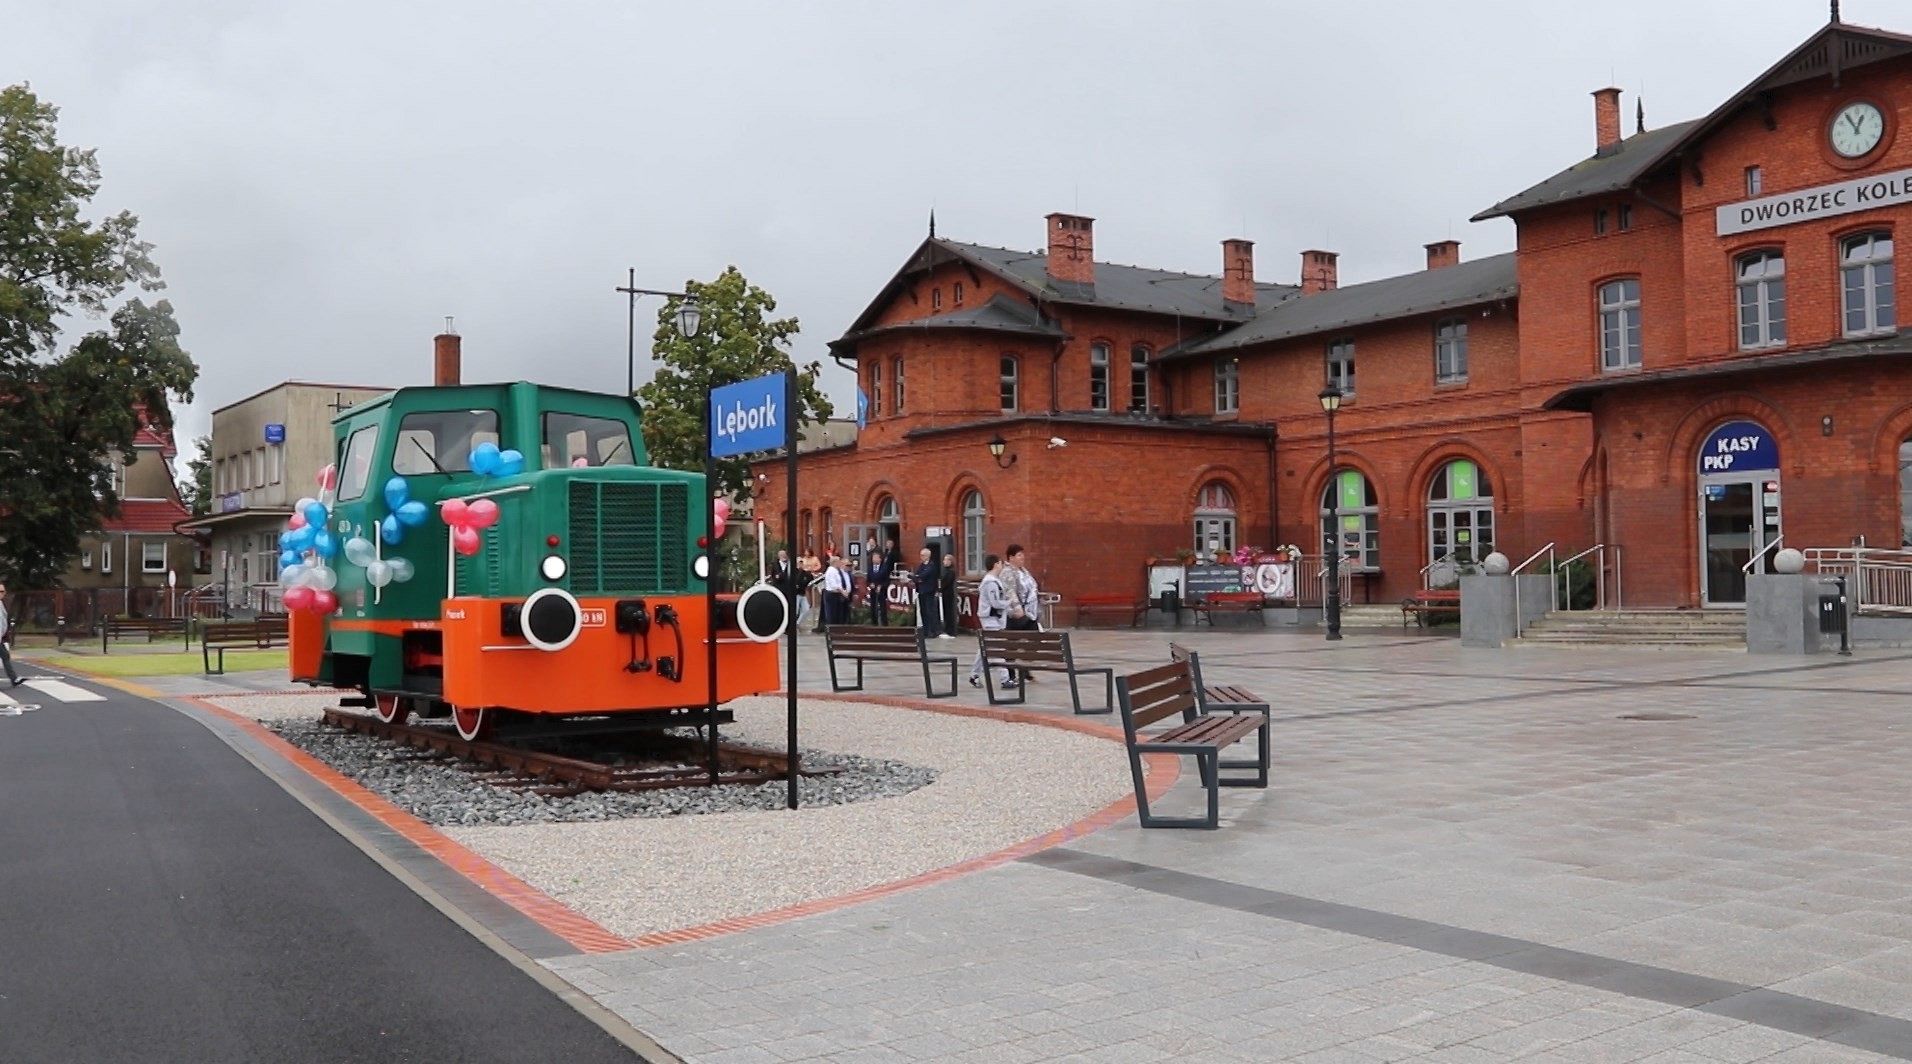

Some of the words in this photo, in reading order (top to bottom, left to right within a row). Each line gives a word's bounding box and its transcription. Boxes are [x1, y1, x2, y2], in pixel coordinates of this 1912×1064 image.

[1740, 189, 1847, 225] DWORZEC
[1857, 176, 1912, 203] KOLE
[717, 393, 777, 443] Lębork
[1717, 435, 1760, 453] KASY
[1703, 454, 1734, 470] PKP
